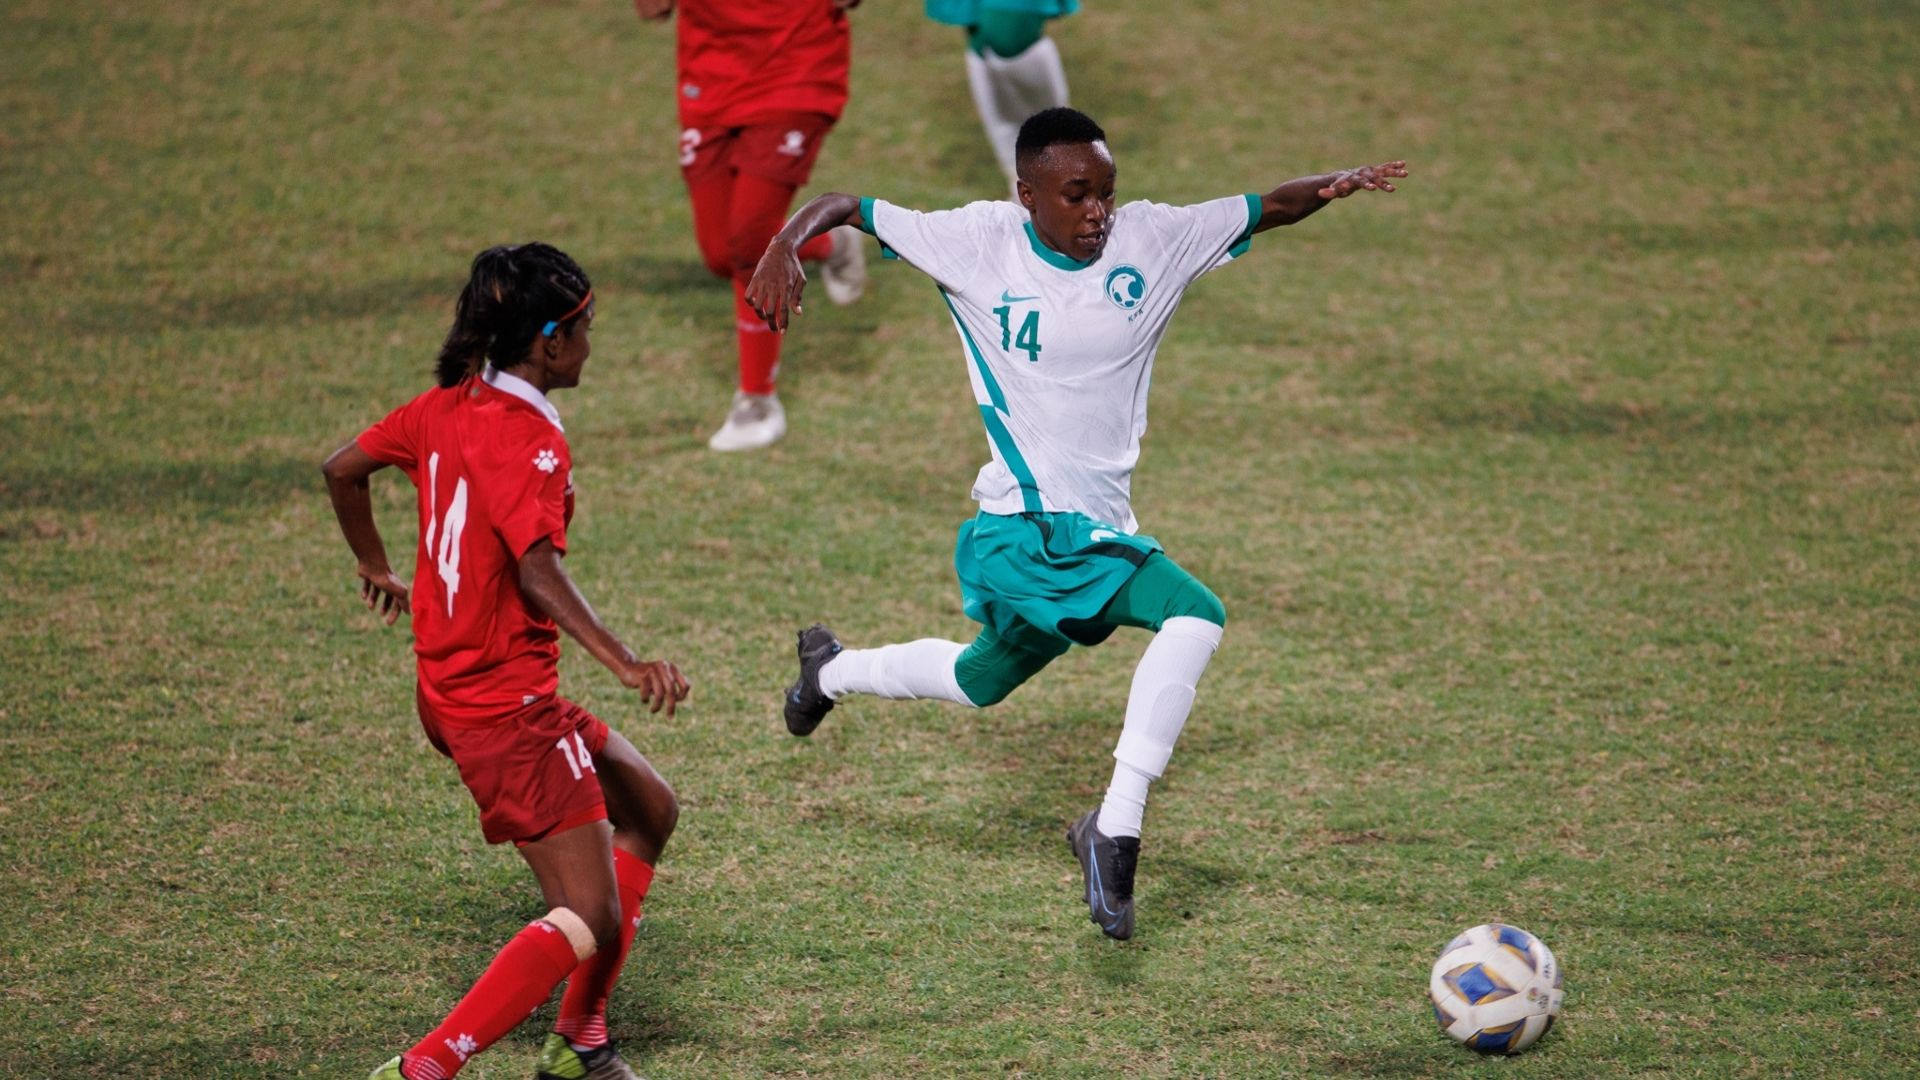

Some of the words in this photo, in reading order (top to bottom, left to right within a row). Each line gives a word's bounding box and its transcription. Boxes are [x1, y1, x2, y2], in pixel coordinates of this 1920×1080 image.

[993, 305, 1042, 362] 14
[426, 451, 468, 619] 14
[556, 730, 596, 780] 14
